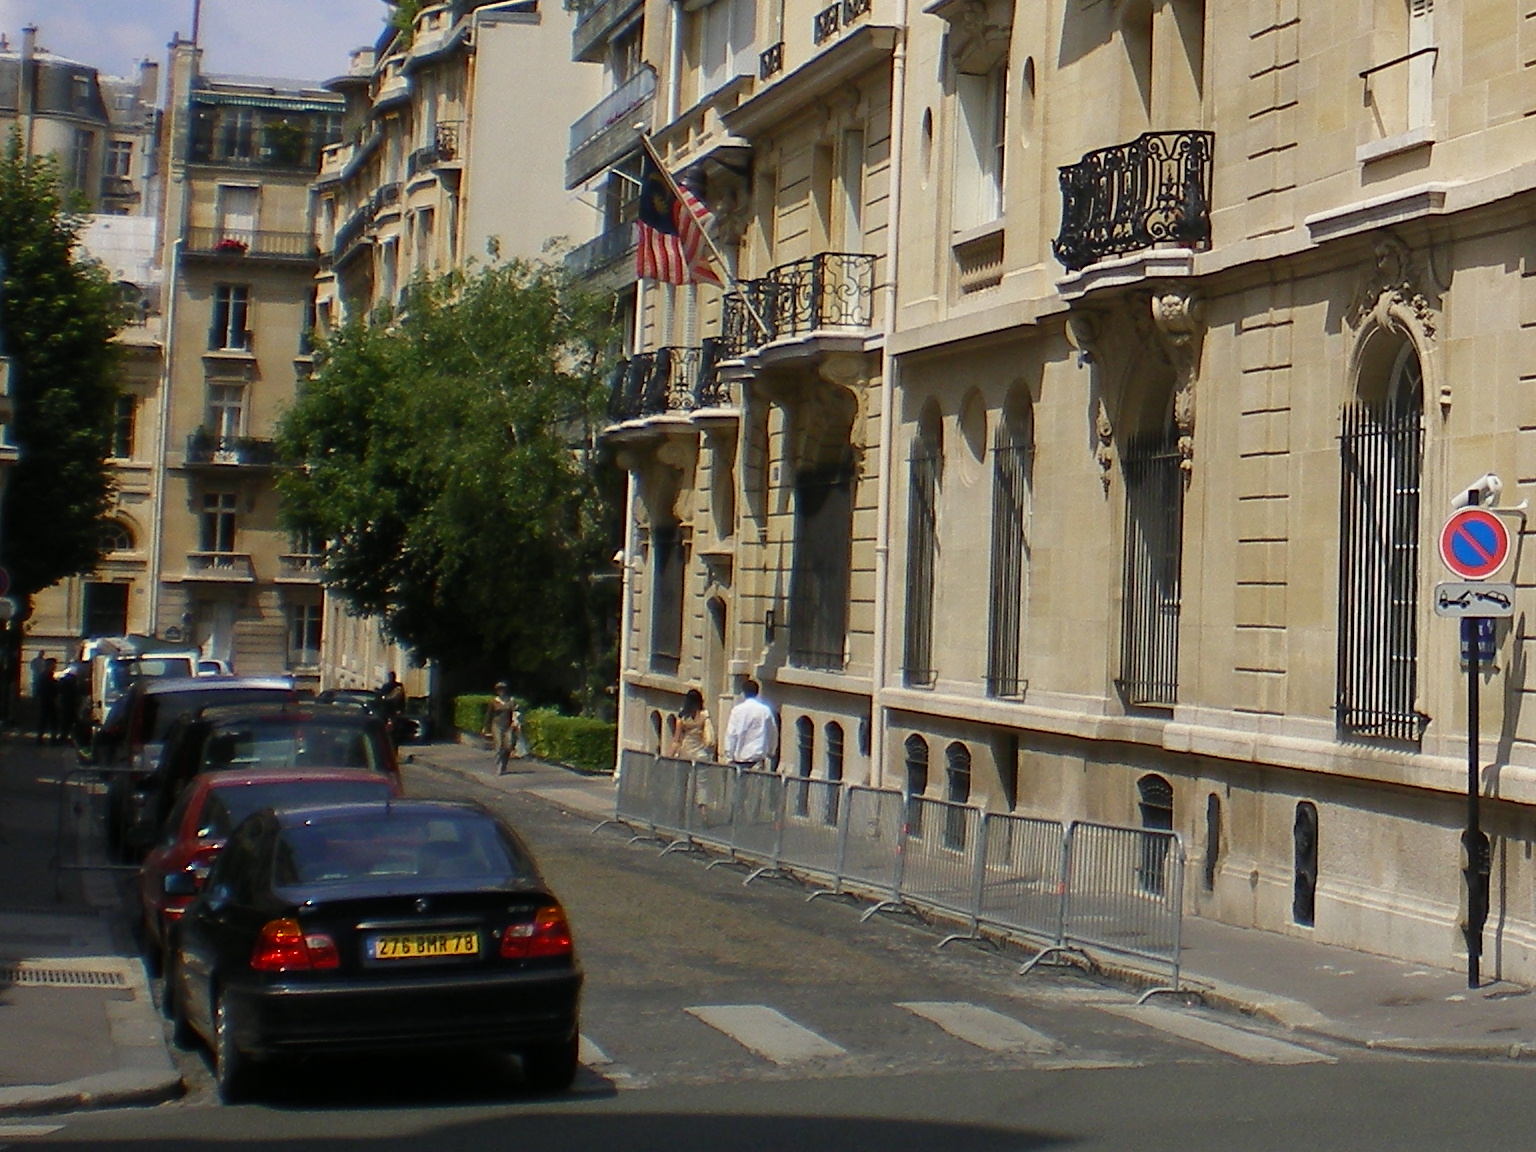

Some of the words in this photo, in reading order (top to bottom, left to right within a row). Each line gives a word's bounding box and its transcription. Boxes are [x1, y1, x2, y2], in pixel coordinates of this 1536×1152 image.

[380, 937, 410, 955] 276
[417, 935, 447, 953] BMR
[453, 933, 473, 951] 78
